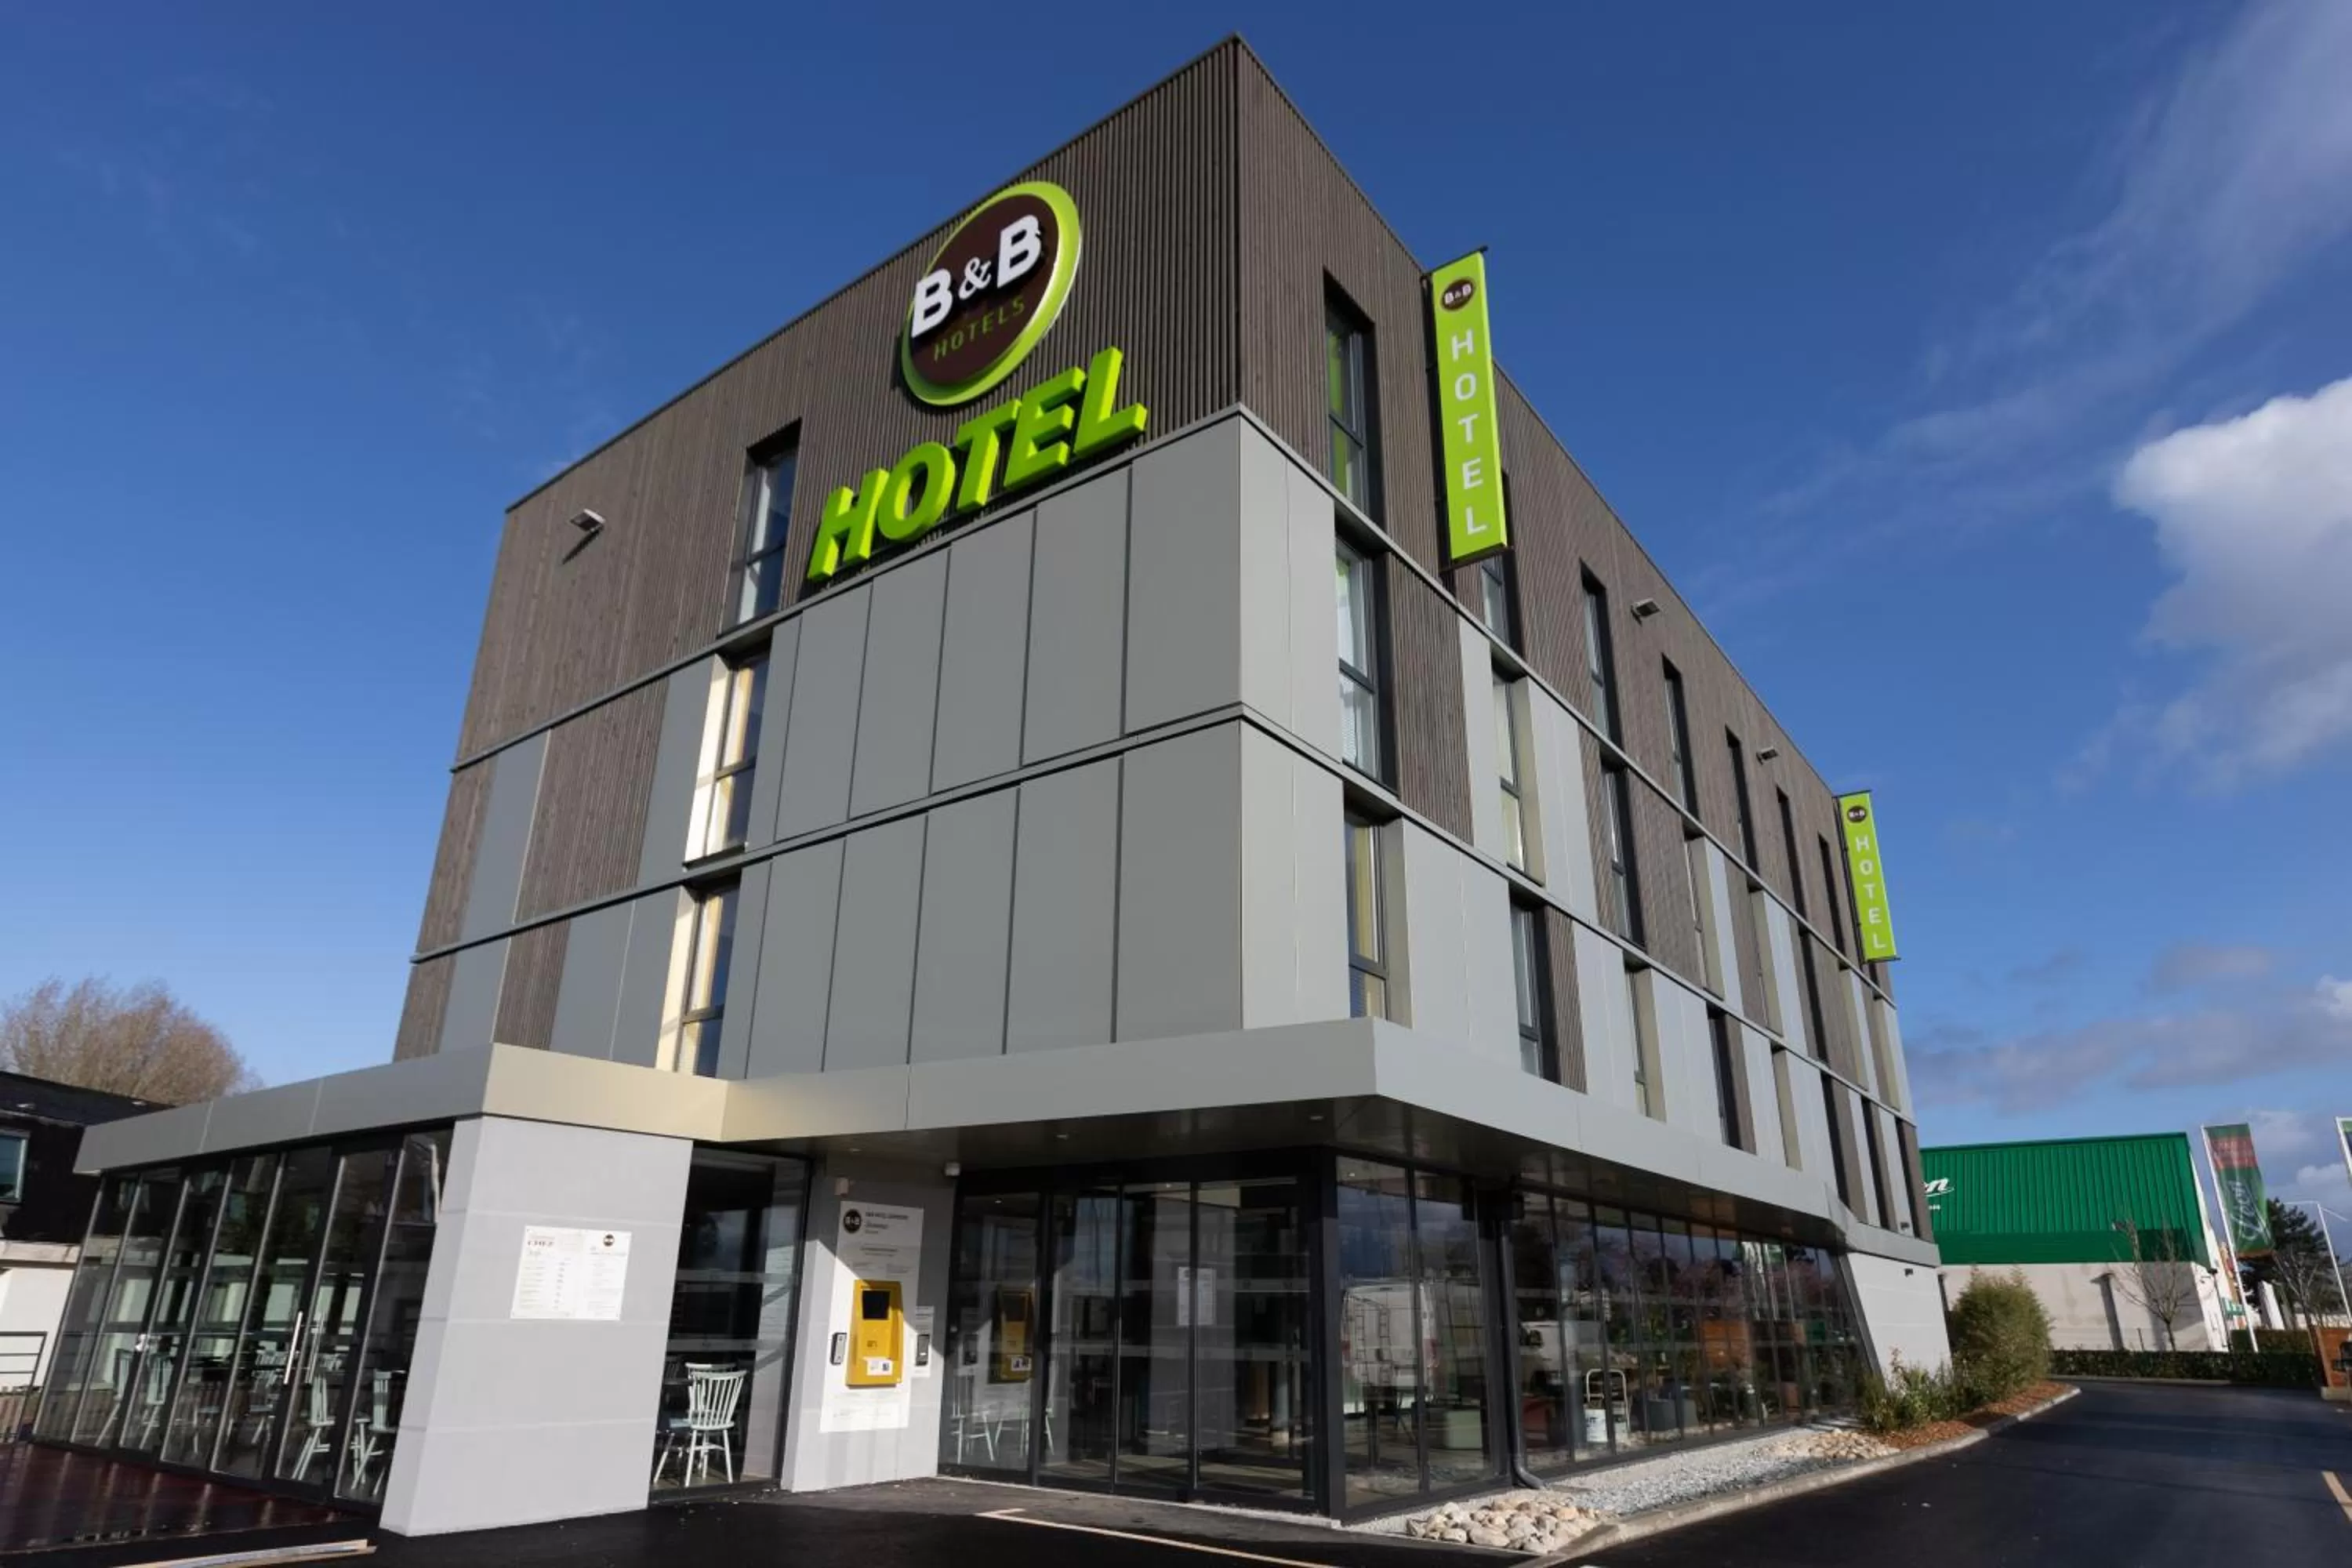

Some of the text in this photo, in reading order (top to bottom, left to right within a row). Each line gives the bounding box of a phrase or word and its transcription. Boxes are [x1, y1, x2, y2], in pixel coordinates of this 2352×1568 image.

[912, 215, 1040, 338] B&B
[934, 295, 1025, 361] HOTELS
[808, 347, 1147, 581] HOTEL
[1451, 328, 1487, 535] HOTEL
[1856, 834, 1886, 949] HOTEL
